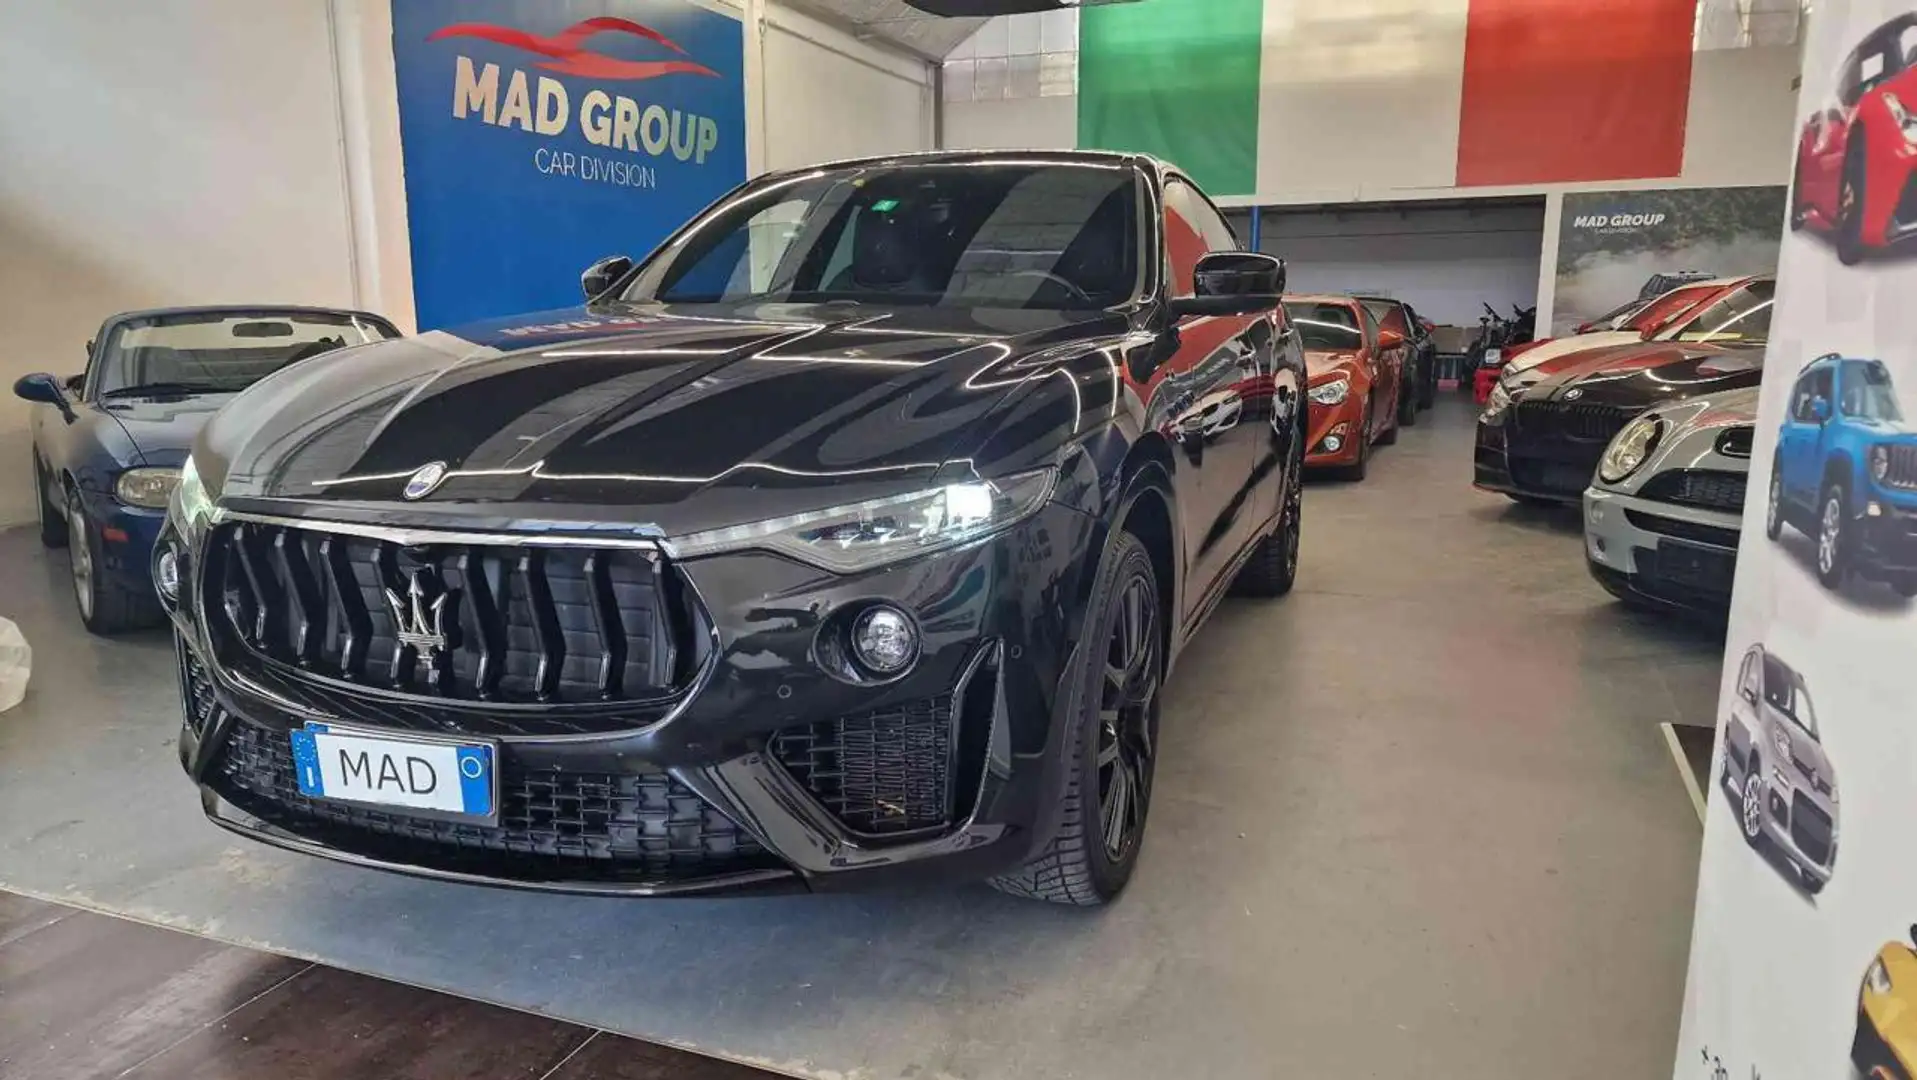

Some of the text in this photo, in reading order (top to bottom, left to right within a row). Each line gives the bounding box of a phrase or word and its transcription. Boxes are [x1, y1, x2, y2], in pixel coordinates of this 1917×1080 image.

[453, 55, 718, 164] MAD GROUP
[535, 148, 656, 190] CAR DIVISION
[1574, 213, 1665, 228] MAD GROUP
[338, 749, 437, 794] MAD
